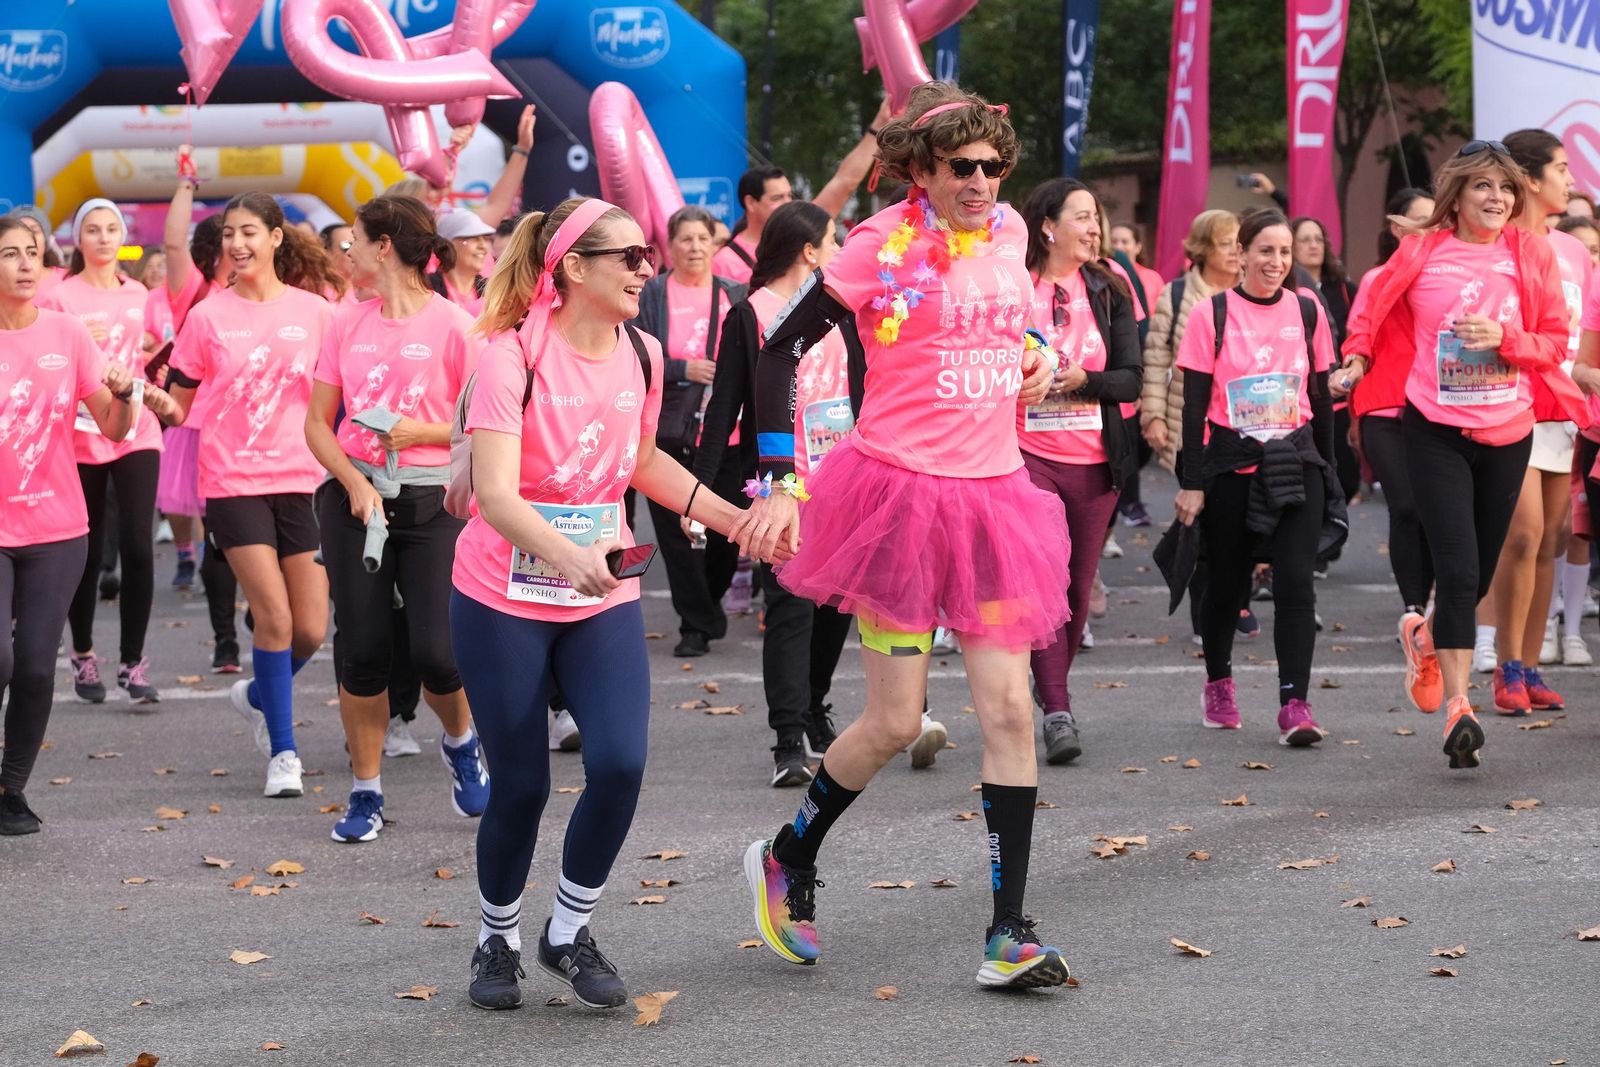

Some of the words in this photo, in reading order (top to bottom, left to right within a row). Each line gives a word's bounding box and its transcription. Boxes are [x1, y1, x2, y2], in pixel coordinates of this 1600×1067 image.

[1063, 18, 1087, 155] ABC
[937, 350, 963, 367] TU
[540, 392, 585, 408] OYSHO
[552, 520, 592, 530] ASTURIANA
[526, 576, 550, 585] CARRERA
[521, 586, 557, 599] OYSHO
